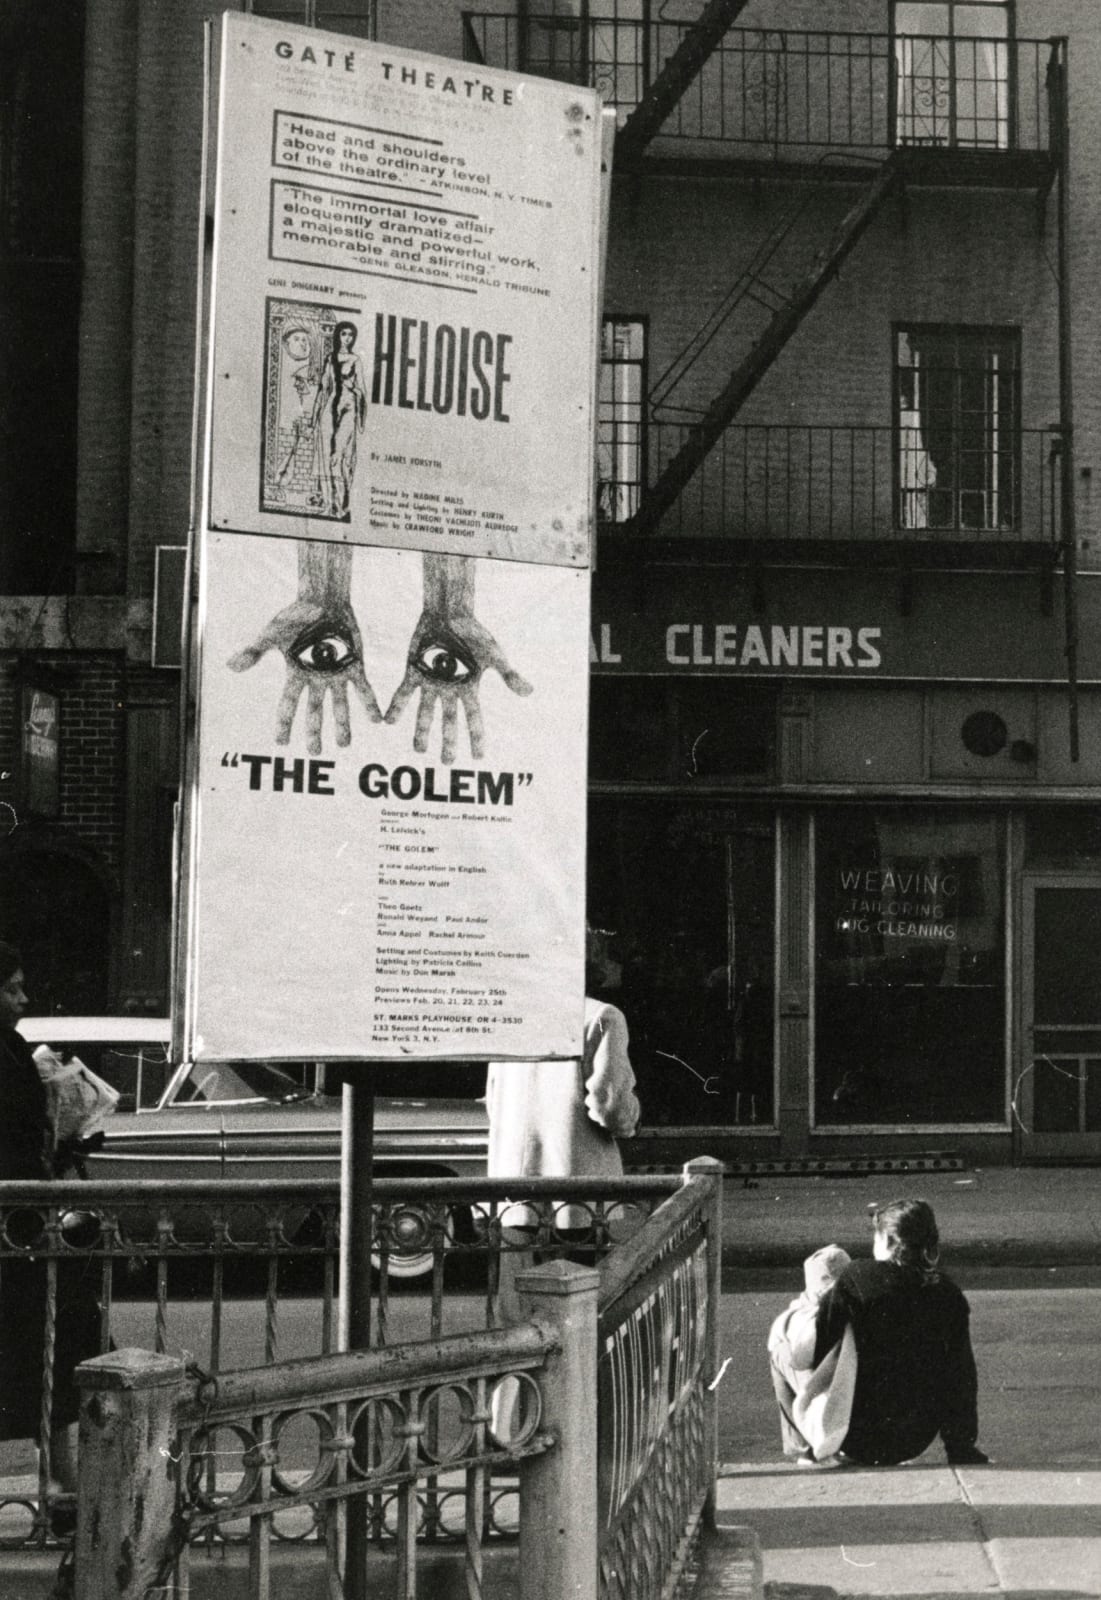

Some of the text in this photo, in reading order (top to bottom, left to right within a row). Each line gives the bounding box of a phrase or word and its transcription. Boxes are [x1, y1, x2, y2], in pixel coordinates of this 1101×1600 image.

[274, 41, 355, 73] GATE
[381, 62, 514, 106] THEATRE
[282, 137, 491, 185] above the ordinary level
[343, 136, 375, 150] and
[382, 143, 466, 167] shoulders
[282, 152, 300, 162] of
[306, 155, 332, 169] the
[520, 196, 553, 209] TIMES
[283, 202, 372, 228] eloquently
[330, 195, 406, 219] immortal
[413, 211, 448, 226] love
[455, 220, 495, 235] affair
[282, 230, 383, 255] memorable
[390, 249, 421, 262] and
[283, 216, 541, 272] a majestic and powerful work,
[395, 262, 452, 279] GLEASON,
[456, 273, 501, 287] HERALD
[505, 281, 552, 297] TRIBUNE
[371, 312, 513, 423] HELOISE
[370, 452, 442, 469] By JAMES FORSYTH
[370, 486, 398, 497] Directed
[401, 490, 410, 499] by
[413, 492, 441, 502] NADINE
[370, 497, 394, 508] Setting
[398, 501, 410, 509] and
[413, 503, 438, 514] Lighting
[454, 507, 477, 517] HENRY
[370, 507, 400, 519] Costumes
[404, 512, 412, 521] by
[369, 518, 475, 538] Music by CRAWFORD WRIGHT
[665, 624, 882, 669] CLEANERS
[221, 751, 535, 806] “THE GOLEM”
[380, 808, 409, 819] George
[462, 813, 489, 822] Robert
[404, 863, 447, 872] adaptation
[458, 865, 487, 874] English
[378, 877, 398, 886] Ruth
[841, 870, 957, 897] WEAVING
[377, 902, 423, 912] Theo Goetz
[850, 899, 945, 919] TAILORING
[377, 912, 405, 921] Ronald
[445, 915, 463, 923] Paul
[377, 929, 397, 937] Anna
[399, 930, 422, 939] Appel
[428, 931, 455, 939] Rachel
[877, 920, 957, 940] CLEANING
[376, 947, 406, 956] Setting
[423, 948, 462, 957] Costumes
[463, 949, 472, 958] by
[376, 957, 408, 966] Lighting
[411, 958, 420, 967] by
[423, 958, 454, 967] Patricia
[375, 967, 399, 975] Music
[401, 968, 410, 976] by
[431, 969, 456, 977] Marsh
[374, 985, 400, 994] Opens
[451, 987, 486, 996] February
[488, 988, 507, 996] 25th
[374, 995, 411, 1004] Previews
[492, 998, 503, 1006] 24
[373, 1024, 389, 1032] 133
[391, 1024, 420, 1033] Second
[421, 1025, 451, 1033] Avenue
[389, 1014, 420, 1022] MARKS
[422, 1014, 473, 1023] PLAYHOUSE
